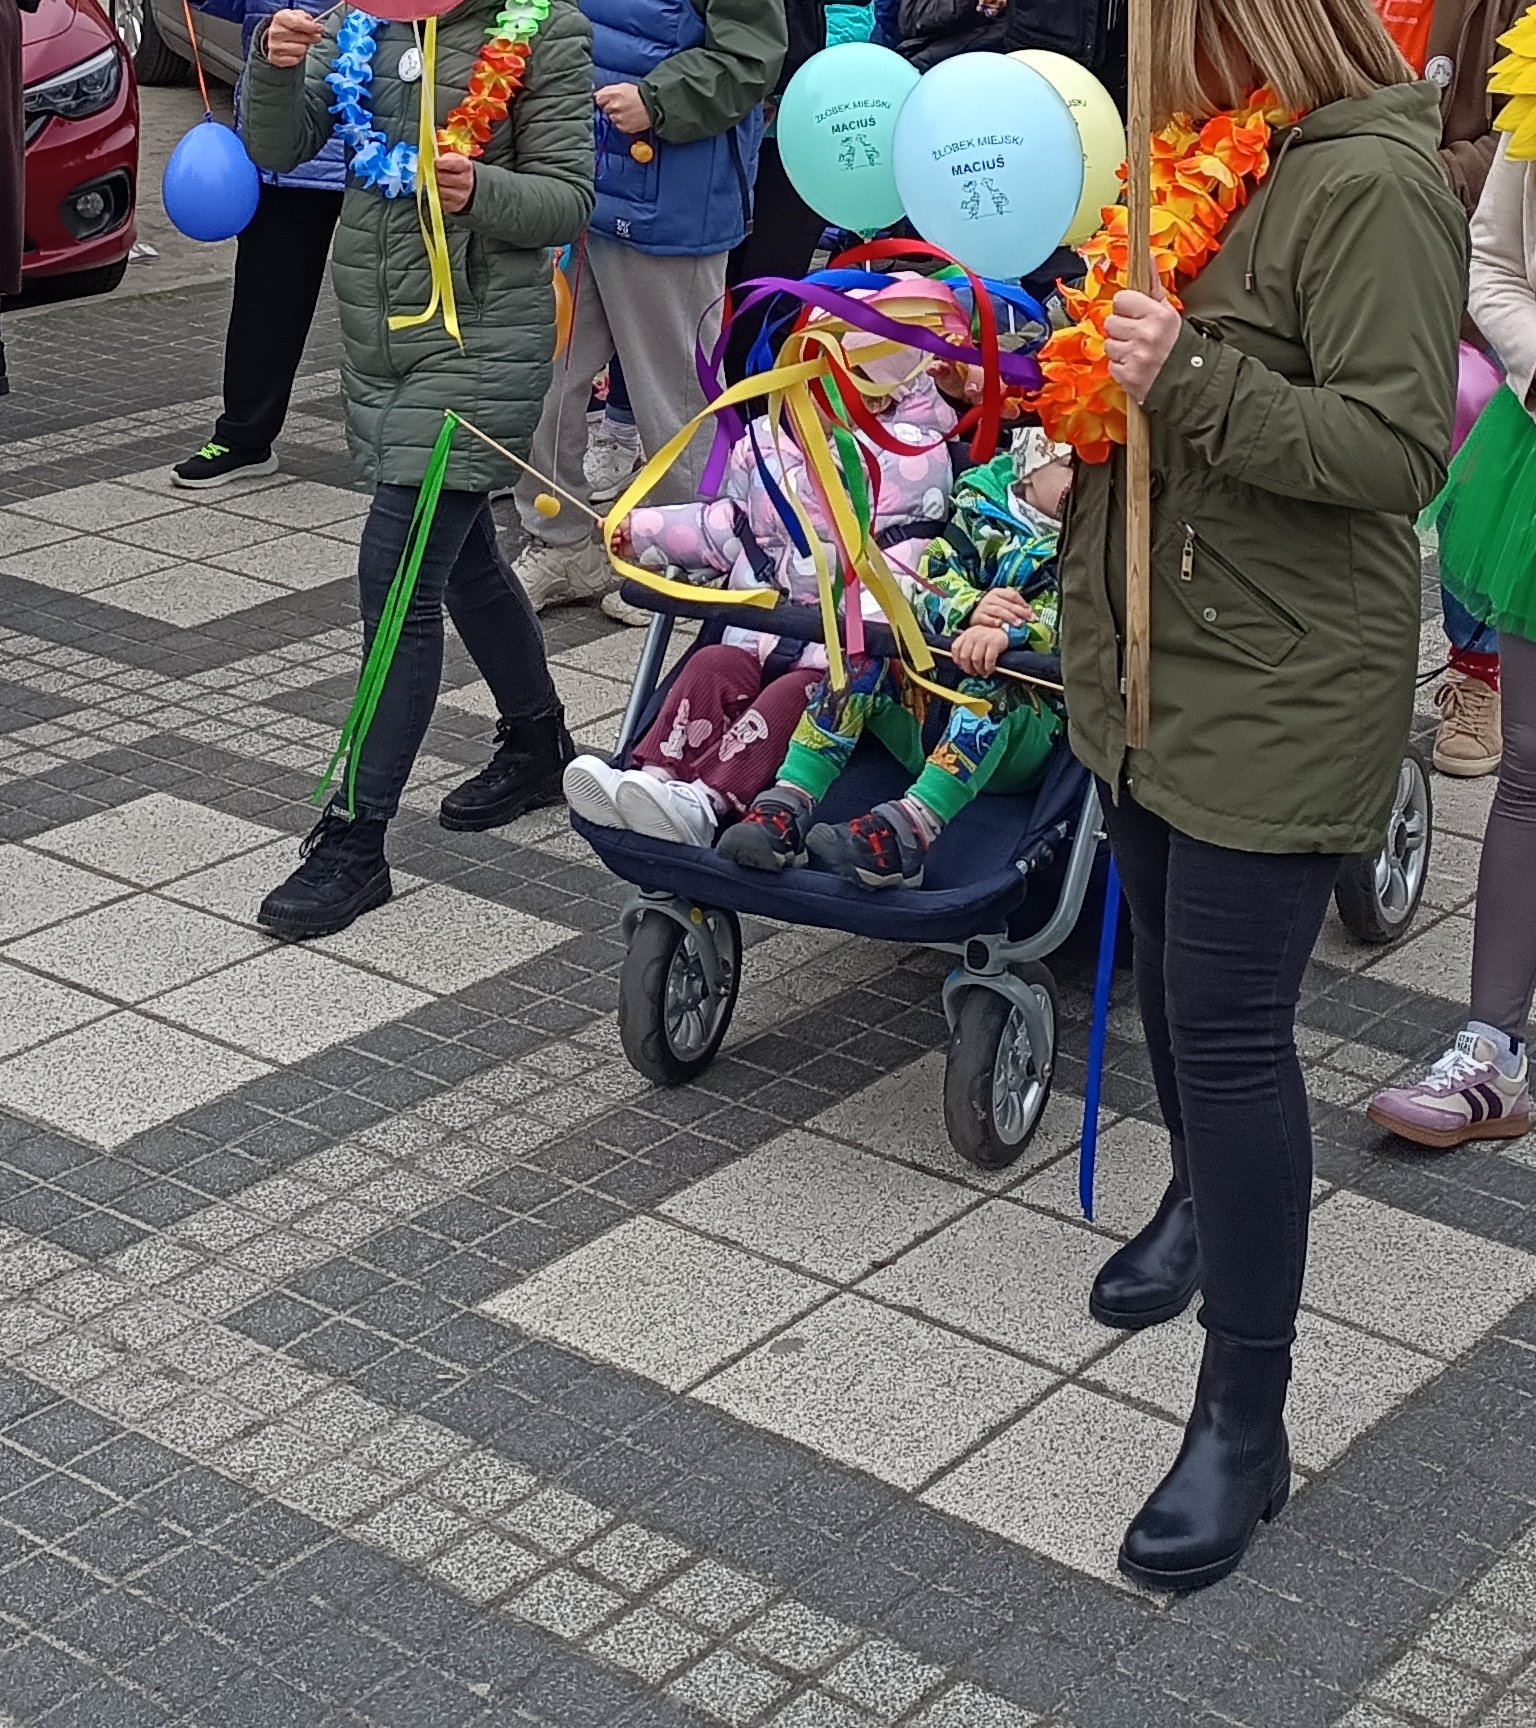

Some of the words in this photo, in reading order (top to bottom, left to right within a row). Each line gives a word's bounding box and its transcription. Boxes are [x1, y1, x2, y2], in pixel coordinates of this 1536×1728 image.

[831, 114, 877, 135] MACIUŚ
[976, 134, 1025, 147] MIEJSKI
[951, 153, 1006, 177] MACIUŚ
